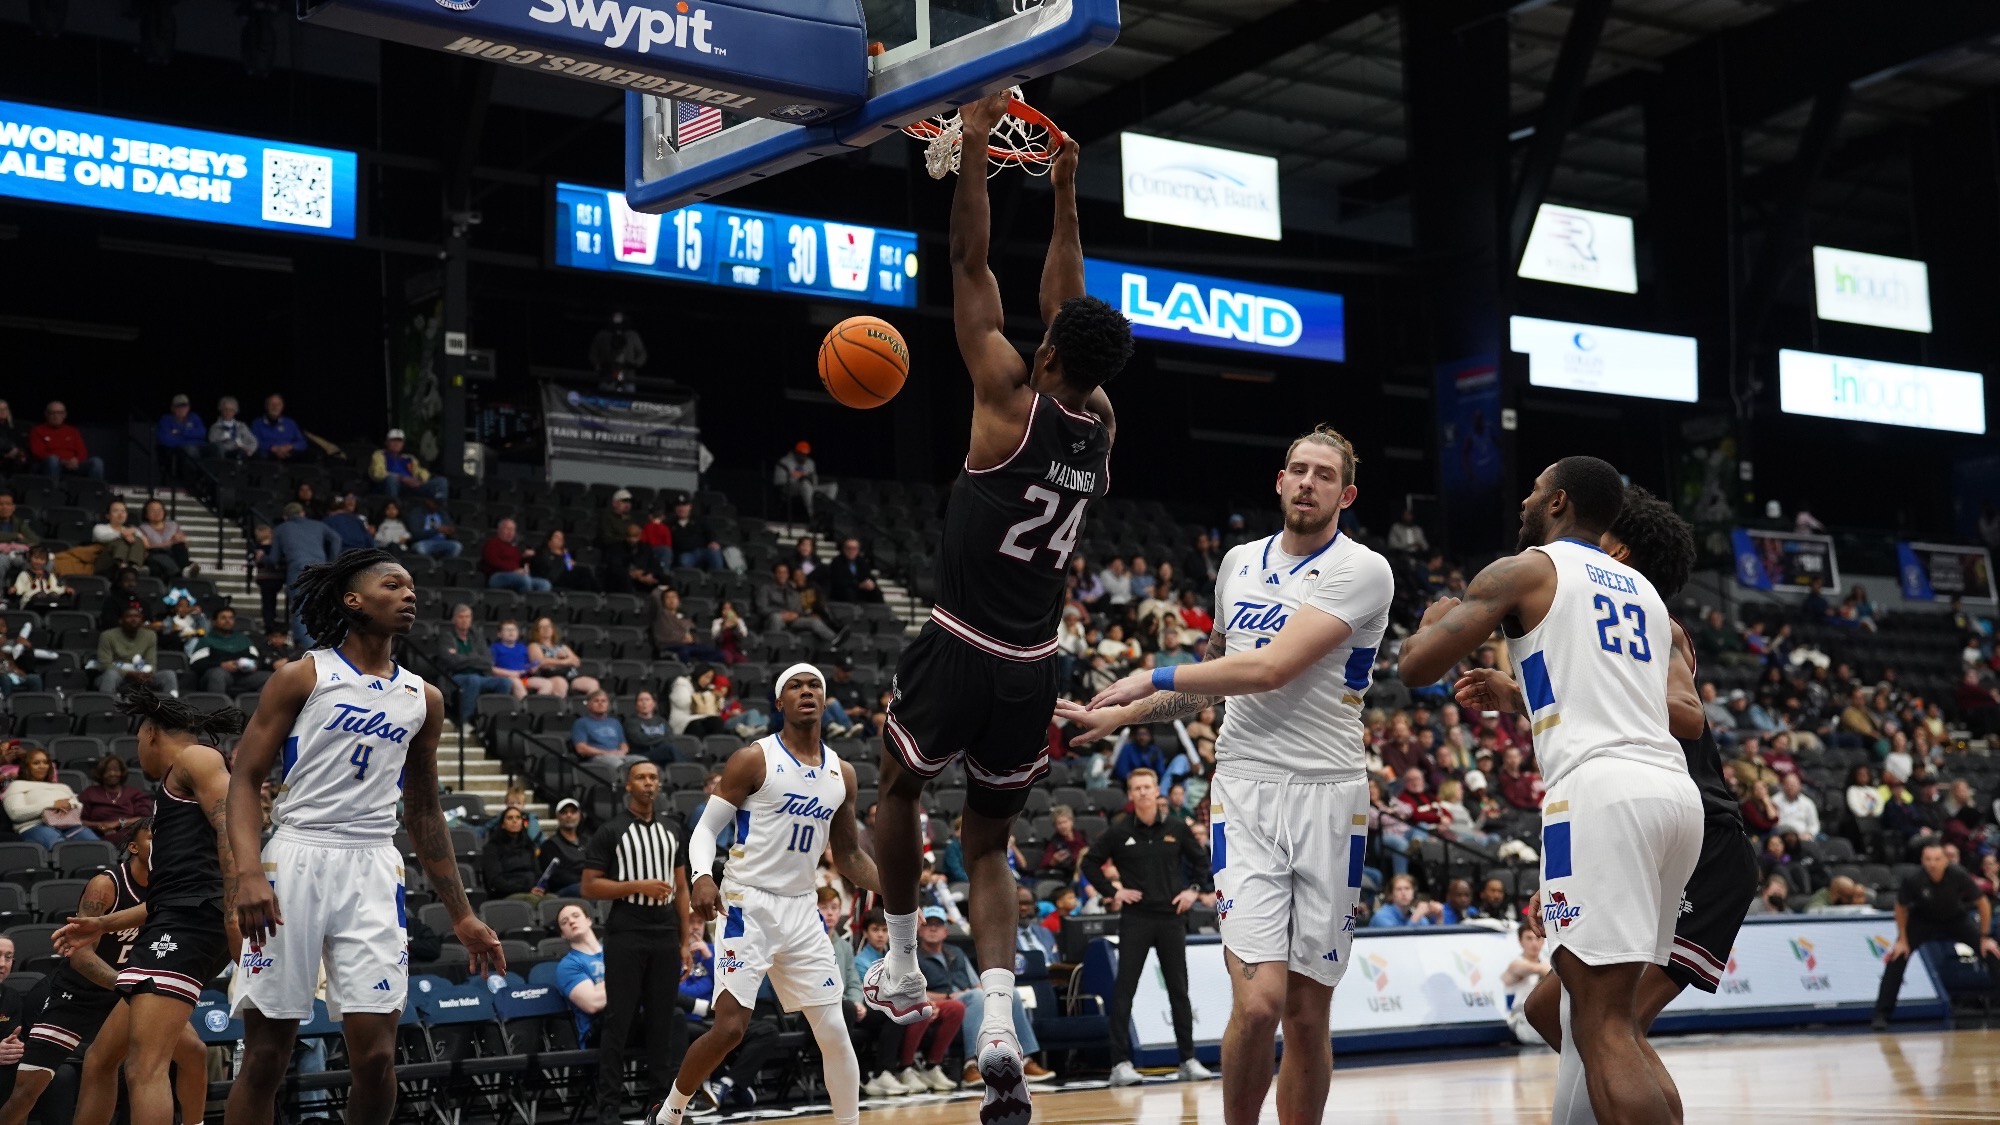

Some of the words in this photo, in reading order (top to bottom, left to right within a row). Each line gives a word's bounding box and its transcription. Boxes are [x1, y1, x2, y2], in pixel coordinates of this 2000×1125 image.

[443, 36, 757, 109] TEXLEGENDS.COM
[0, 151, 66, 182] ALE
[74, 161, 124, 189] ON
[133, 169, 232, 204] DASH!
[111, 138, 248, 179] JERSEYS
[1224, 186, 1270, 211] Bank
[674, 210, 702, 271] 15
[728, 216, 764, 262] 7:19
[788, 224, 817, 285] 30
[1121, 272, 1303, 347] LAND
[1044, 460, 1096, 492] MALONGA
[999, 484, 1089, 569] 24
[1585, 563, 1638, 595] GREEN
[1226, 601, 1289, 632] Tuls
[1593, 593, 1651, 663] 23
[324, 703, 409, 743] Tulsa
[350, 743, 374, 780] 4
[775, 793, 834, 821] Tulsa
[787, 823, 814, 853] 10
[1544, 902, 1581, 922] Tulsa
[242, 951, 274, 970] Tulsa
[717, 957, 745, 969] Tulsa
